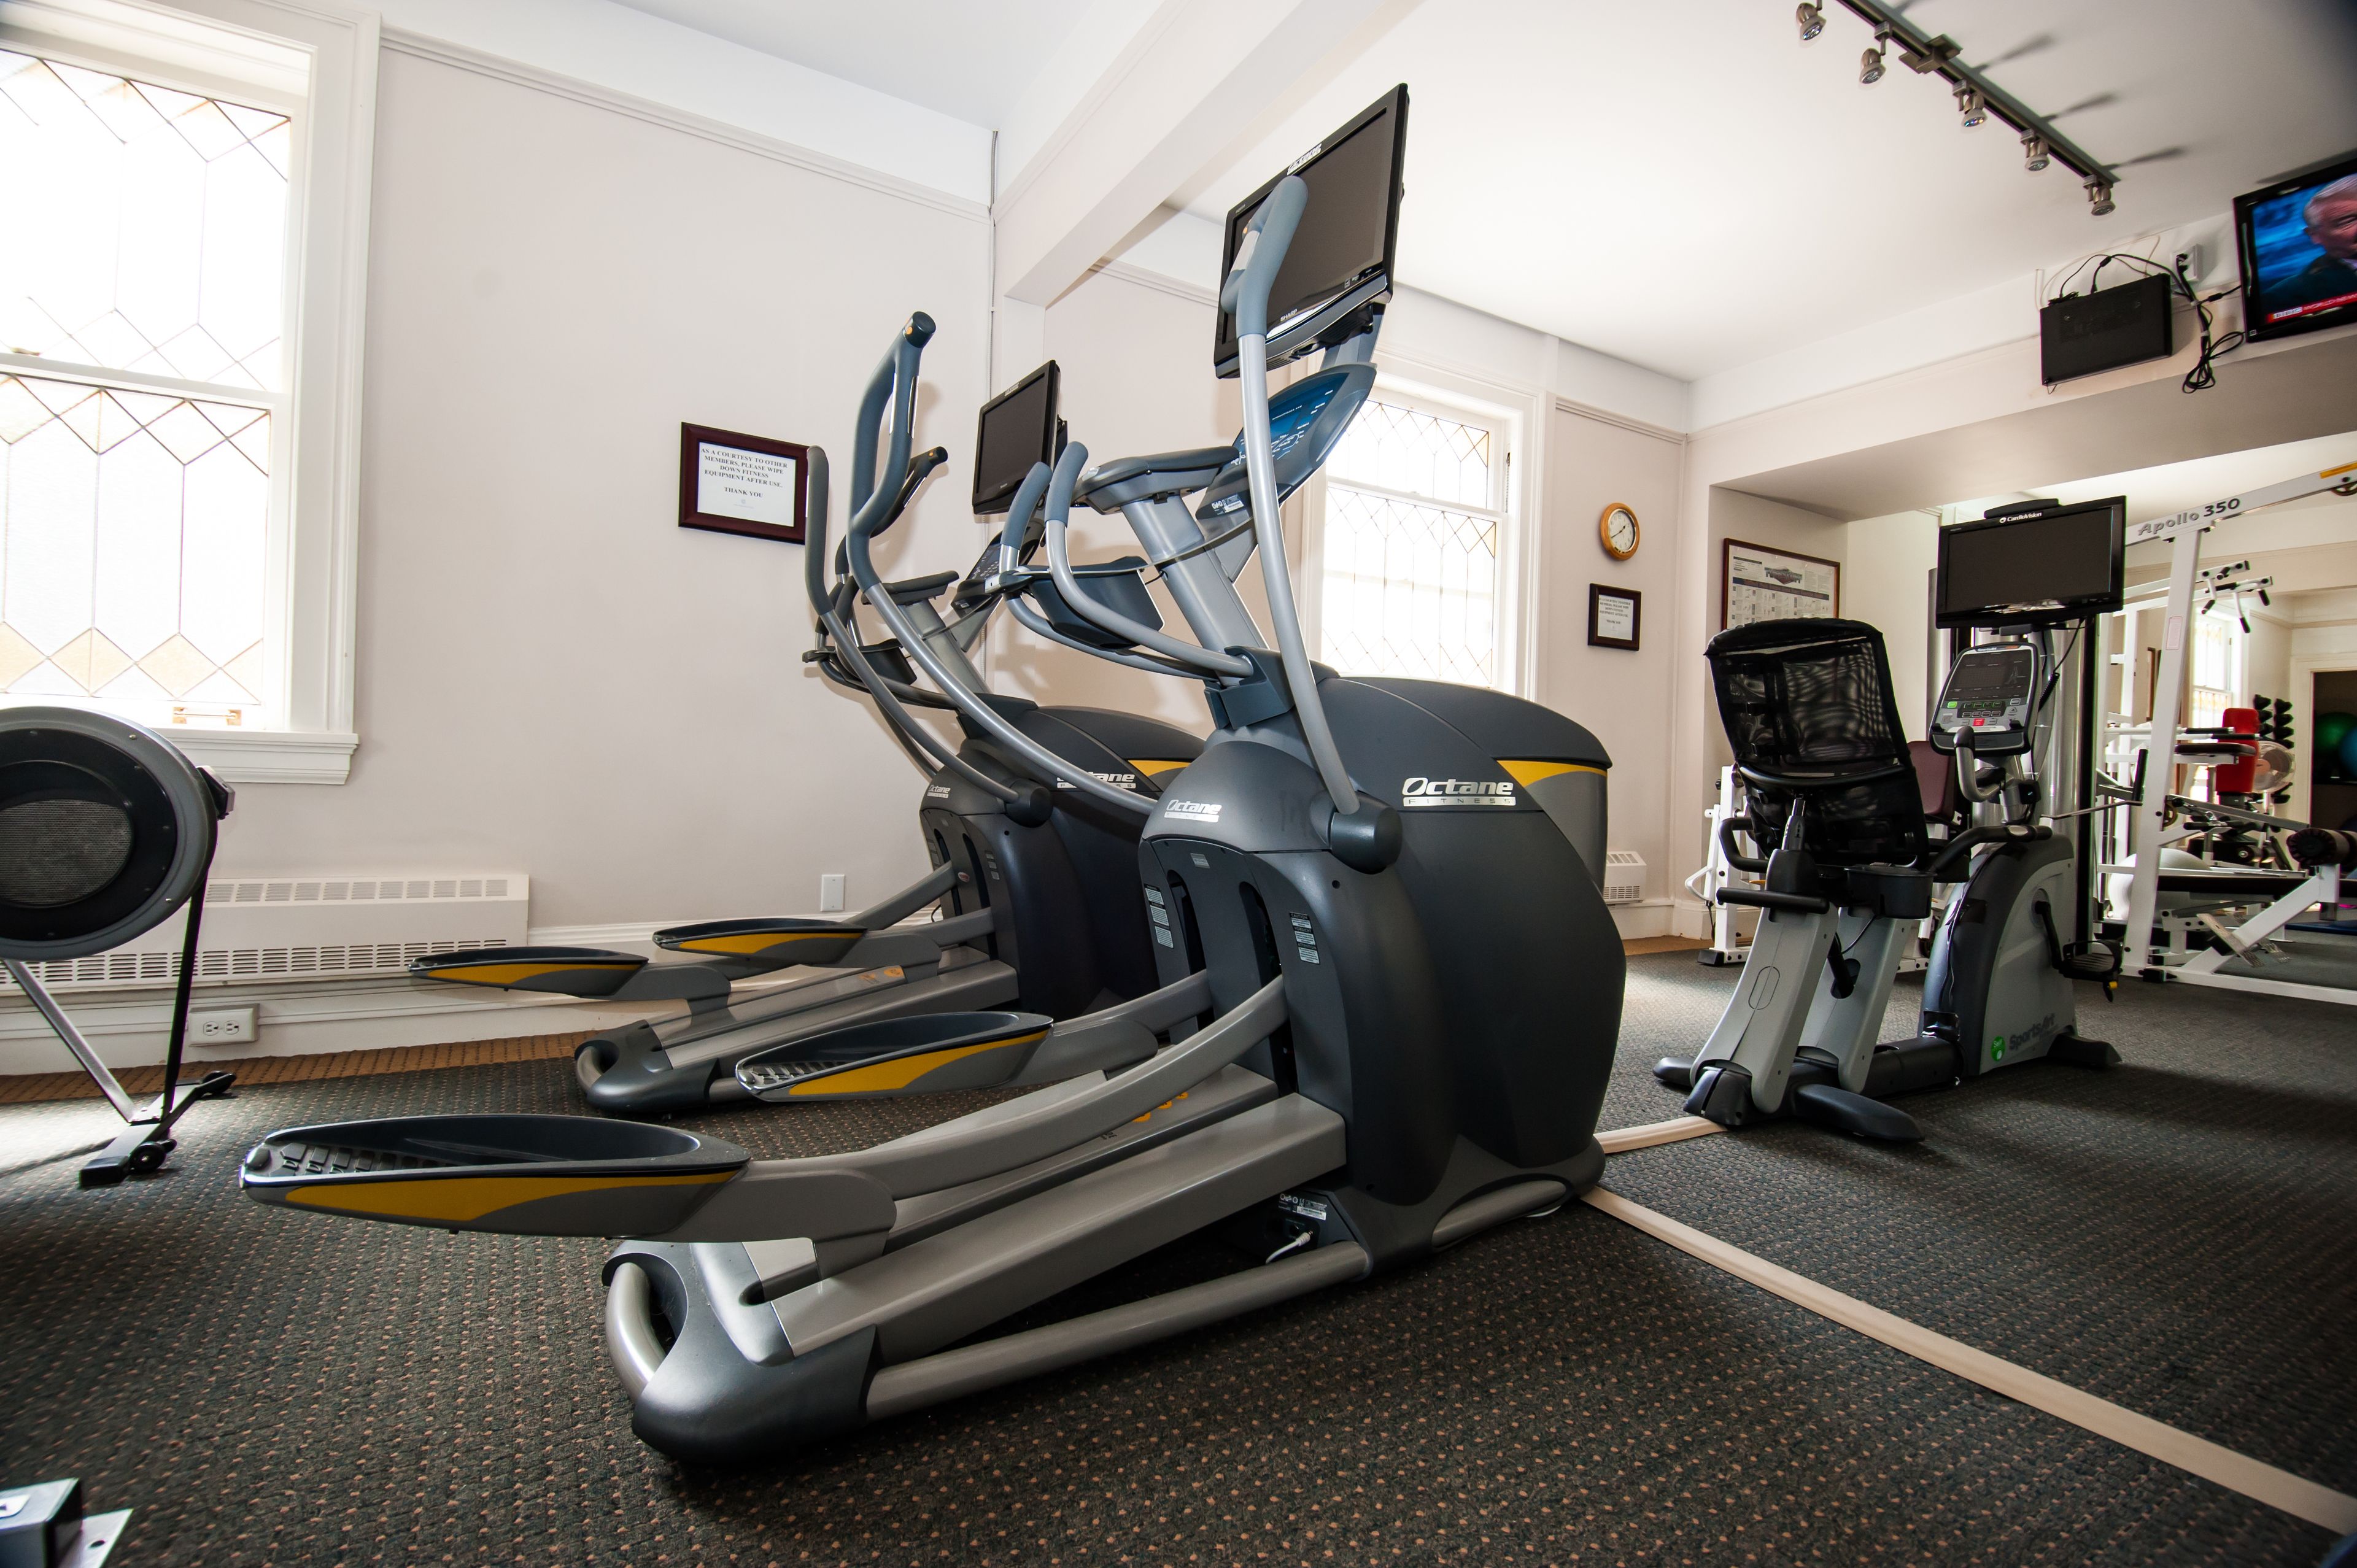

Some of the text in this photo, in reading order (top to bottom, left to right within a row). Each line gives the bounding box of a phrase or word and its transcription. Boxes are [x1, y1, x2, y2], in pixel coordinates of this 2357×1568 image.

[1280, 308, 1298, 322] SHARP
[705, 455, 740, 466] MEMBERS,
[741, 462, 765, 471] PLEASE
[717, 450, 753, 462] COURTESY
[765, 460, 788, 468] OTHER
[705, 469, 745, 481] EQUIPMENT
[743, 469, 768, 478] FITNESS
[724, 487, 748, 495] THANK
[2007, 512, 2042, 522] CardioVision
[2138, 498, 2240, 536] Apollo 350
[928, 784, 951, 793] Octane
[1402, 778, 1514, 795] Octane
[1166, 800, 1222, 814] Octane
